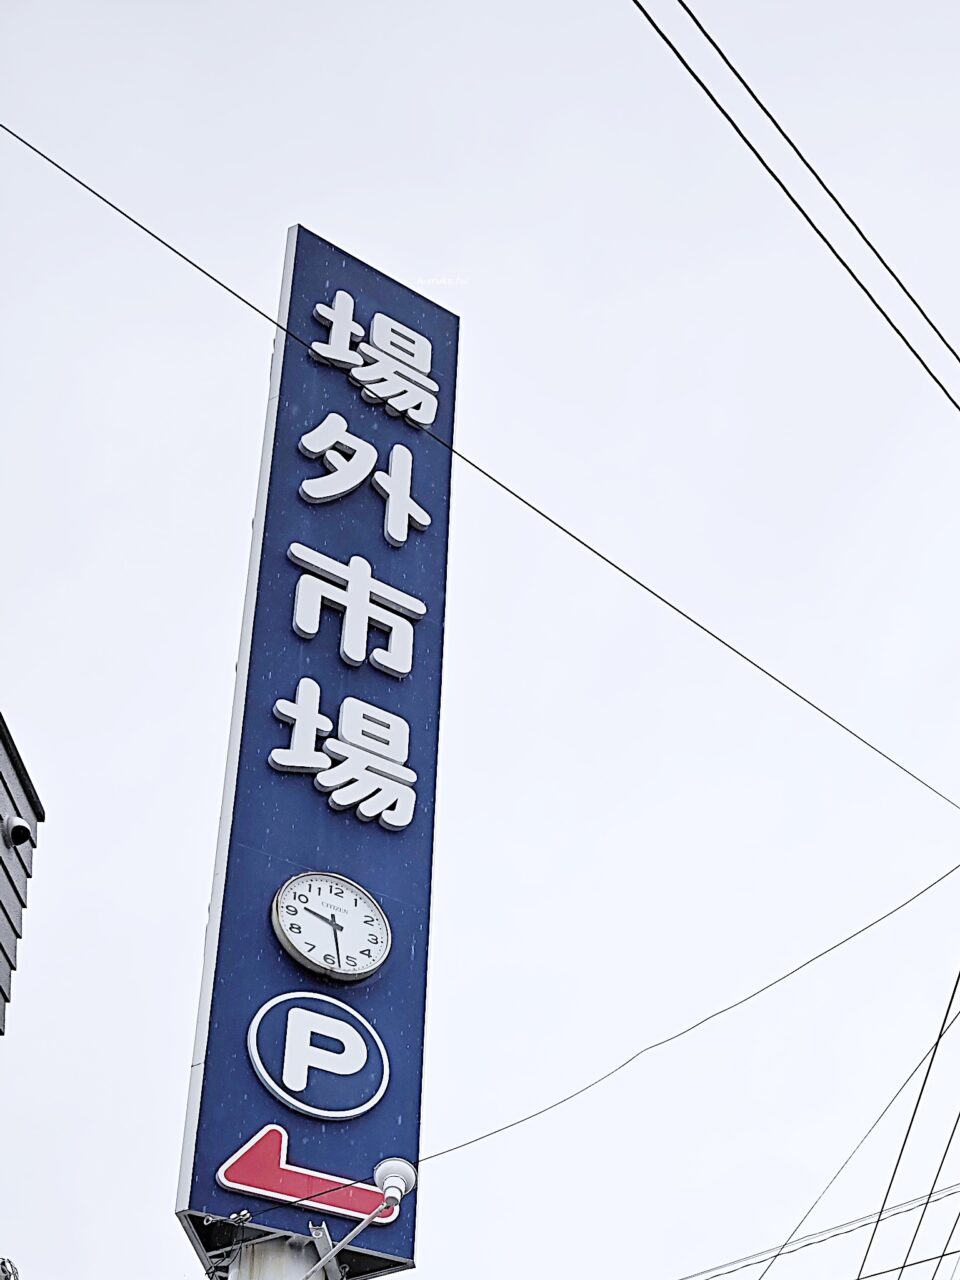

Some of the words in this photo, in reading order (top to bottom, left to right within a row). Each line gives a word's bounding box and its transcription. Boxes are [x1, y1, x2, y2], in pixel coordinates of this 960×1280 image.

[267, 289, 440, 831] 場外市場
[308, 883, 321, 896] 11
[329, 885, 344, 898] 12
[292, 891, 309, 904] 10
[353, 898, 358, 908] 1
[285, 905, 299, 916] 9
[321, 901, 349, 915] CITIZEN
[363, 915, 375, 926] 2
[288, 923, 302, 935] 8
[367, 933, 379, 945] 3
[304, 941, 316, 953] 7
[323, 953, 336, 966] 6
[359, 948, 373, 959] 4
[345, 955, 358, 967] 5
[282, 1007, 368, 1092] P
